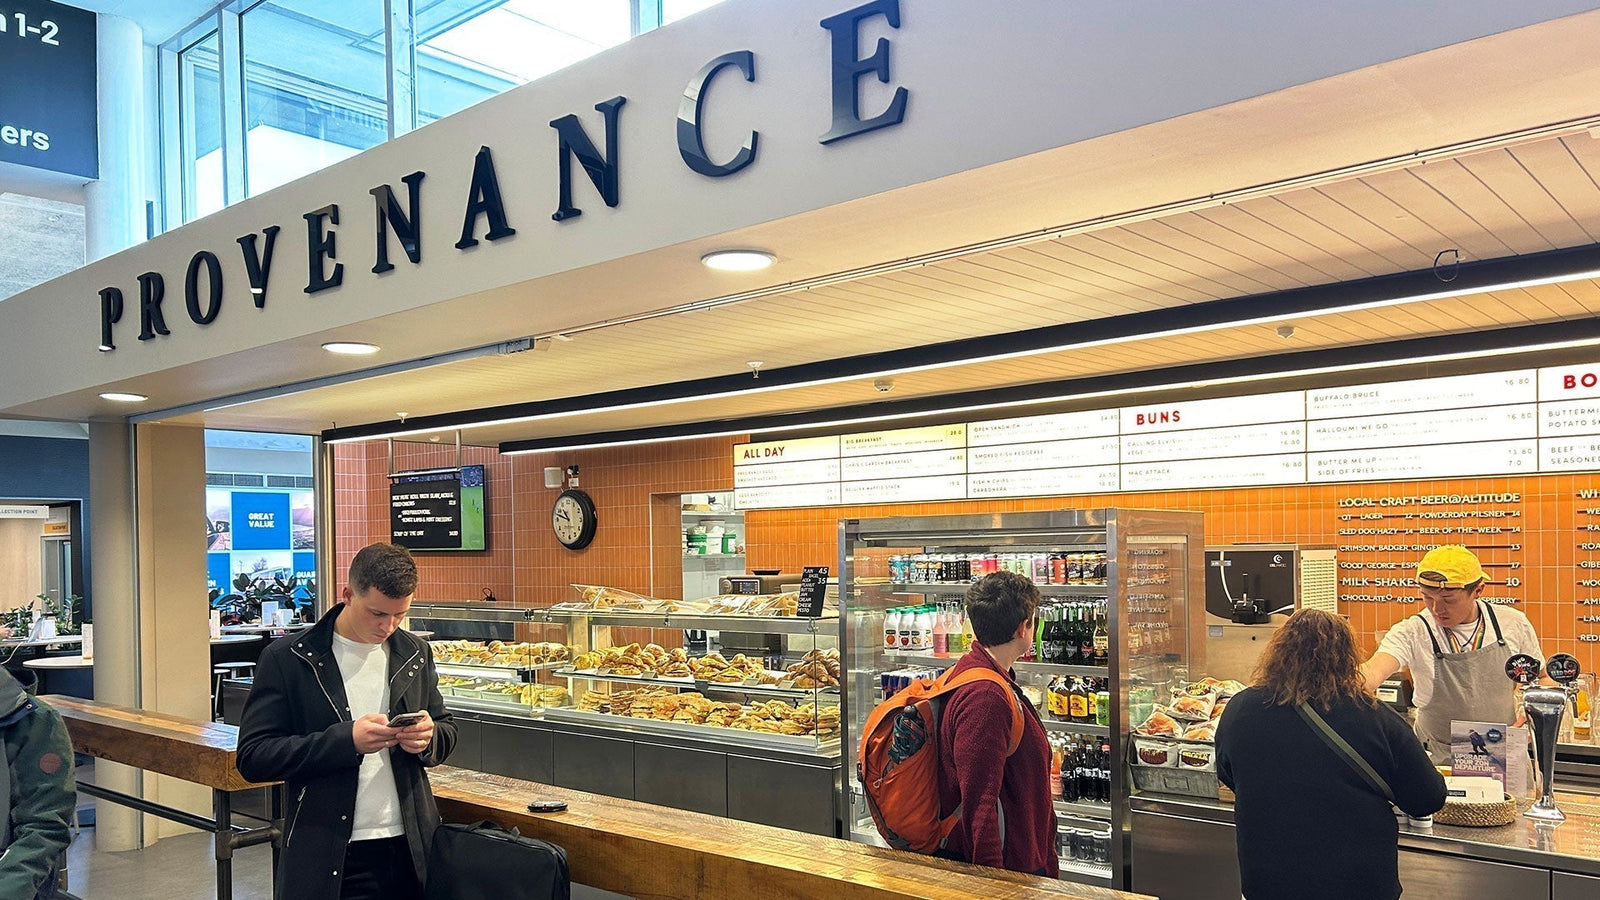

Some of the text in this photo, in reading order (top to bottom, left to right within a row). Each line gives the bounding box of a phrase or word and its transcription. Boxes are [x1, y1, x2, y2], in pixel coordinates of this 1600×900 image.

[14, 12, 60, 46] 1-2
[97, 0, 909, 351] PROVENANCE
[1563, 372, 1598, 390] BO
[1314, 393, 1349, 402] BUFFALO
[1136, 410, 1181, 426] BUNS
[1548, 419, 1587, 427] POTATO
[743, 446, 785, 460] ALL DAY
[1551, 446, 1574, 454] BEEF
[1339, 493, 1520, 507] LOCAL CRAFT BEER@ALTITUDE
[1342, 577, 1369, 586] MILK
[1506, 578, 1520, 586] 10
[1454, 764, 1496, 772] DEPARTURE
